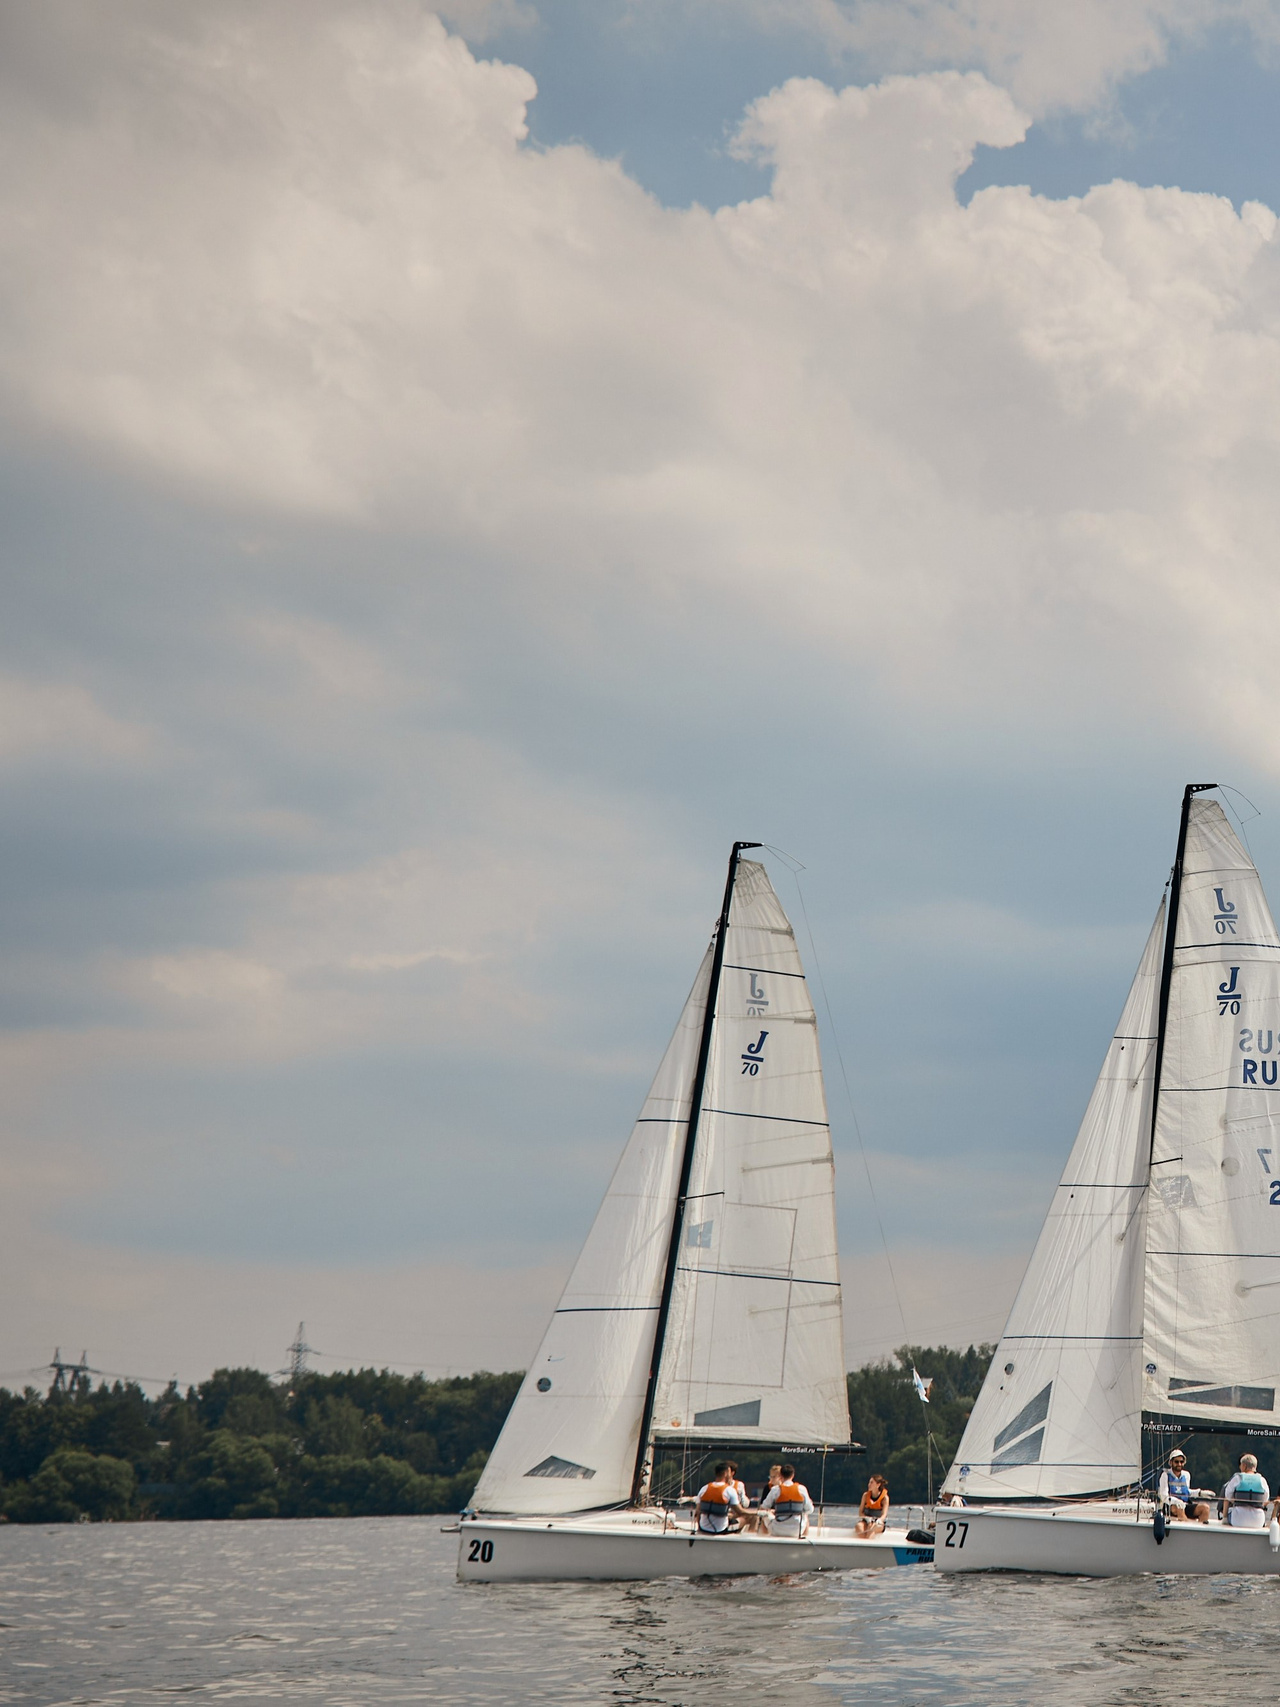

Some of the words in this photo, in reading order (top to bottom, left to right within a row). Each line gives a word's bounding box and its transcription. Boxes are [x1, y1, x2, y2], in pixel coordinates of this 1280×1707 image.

[1219, 967, 1240, 993] J
[1219, 1000, 1241, 1016] 70
[747, 1031, 769, 1054] J
[741, 1062, 759, 1076] 70
[945, 1521, 969, 1548] 27
[467, 1539, 494, 1563] 20
